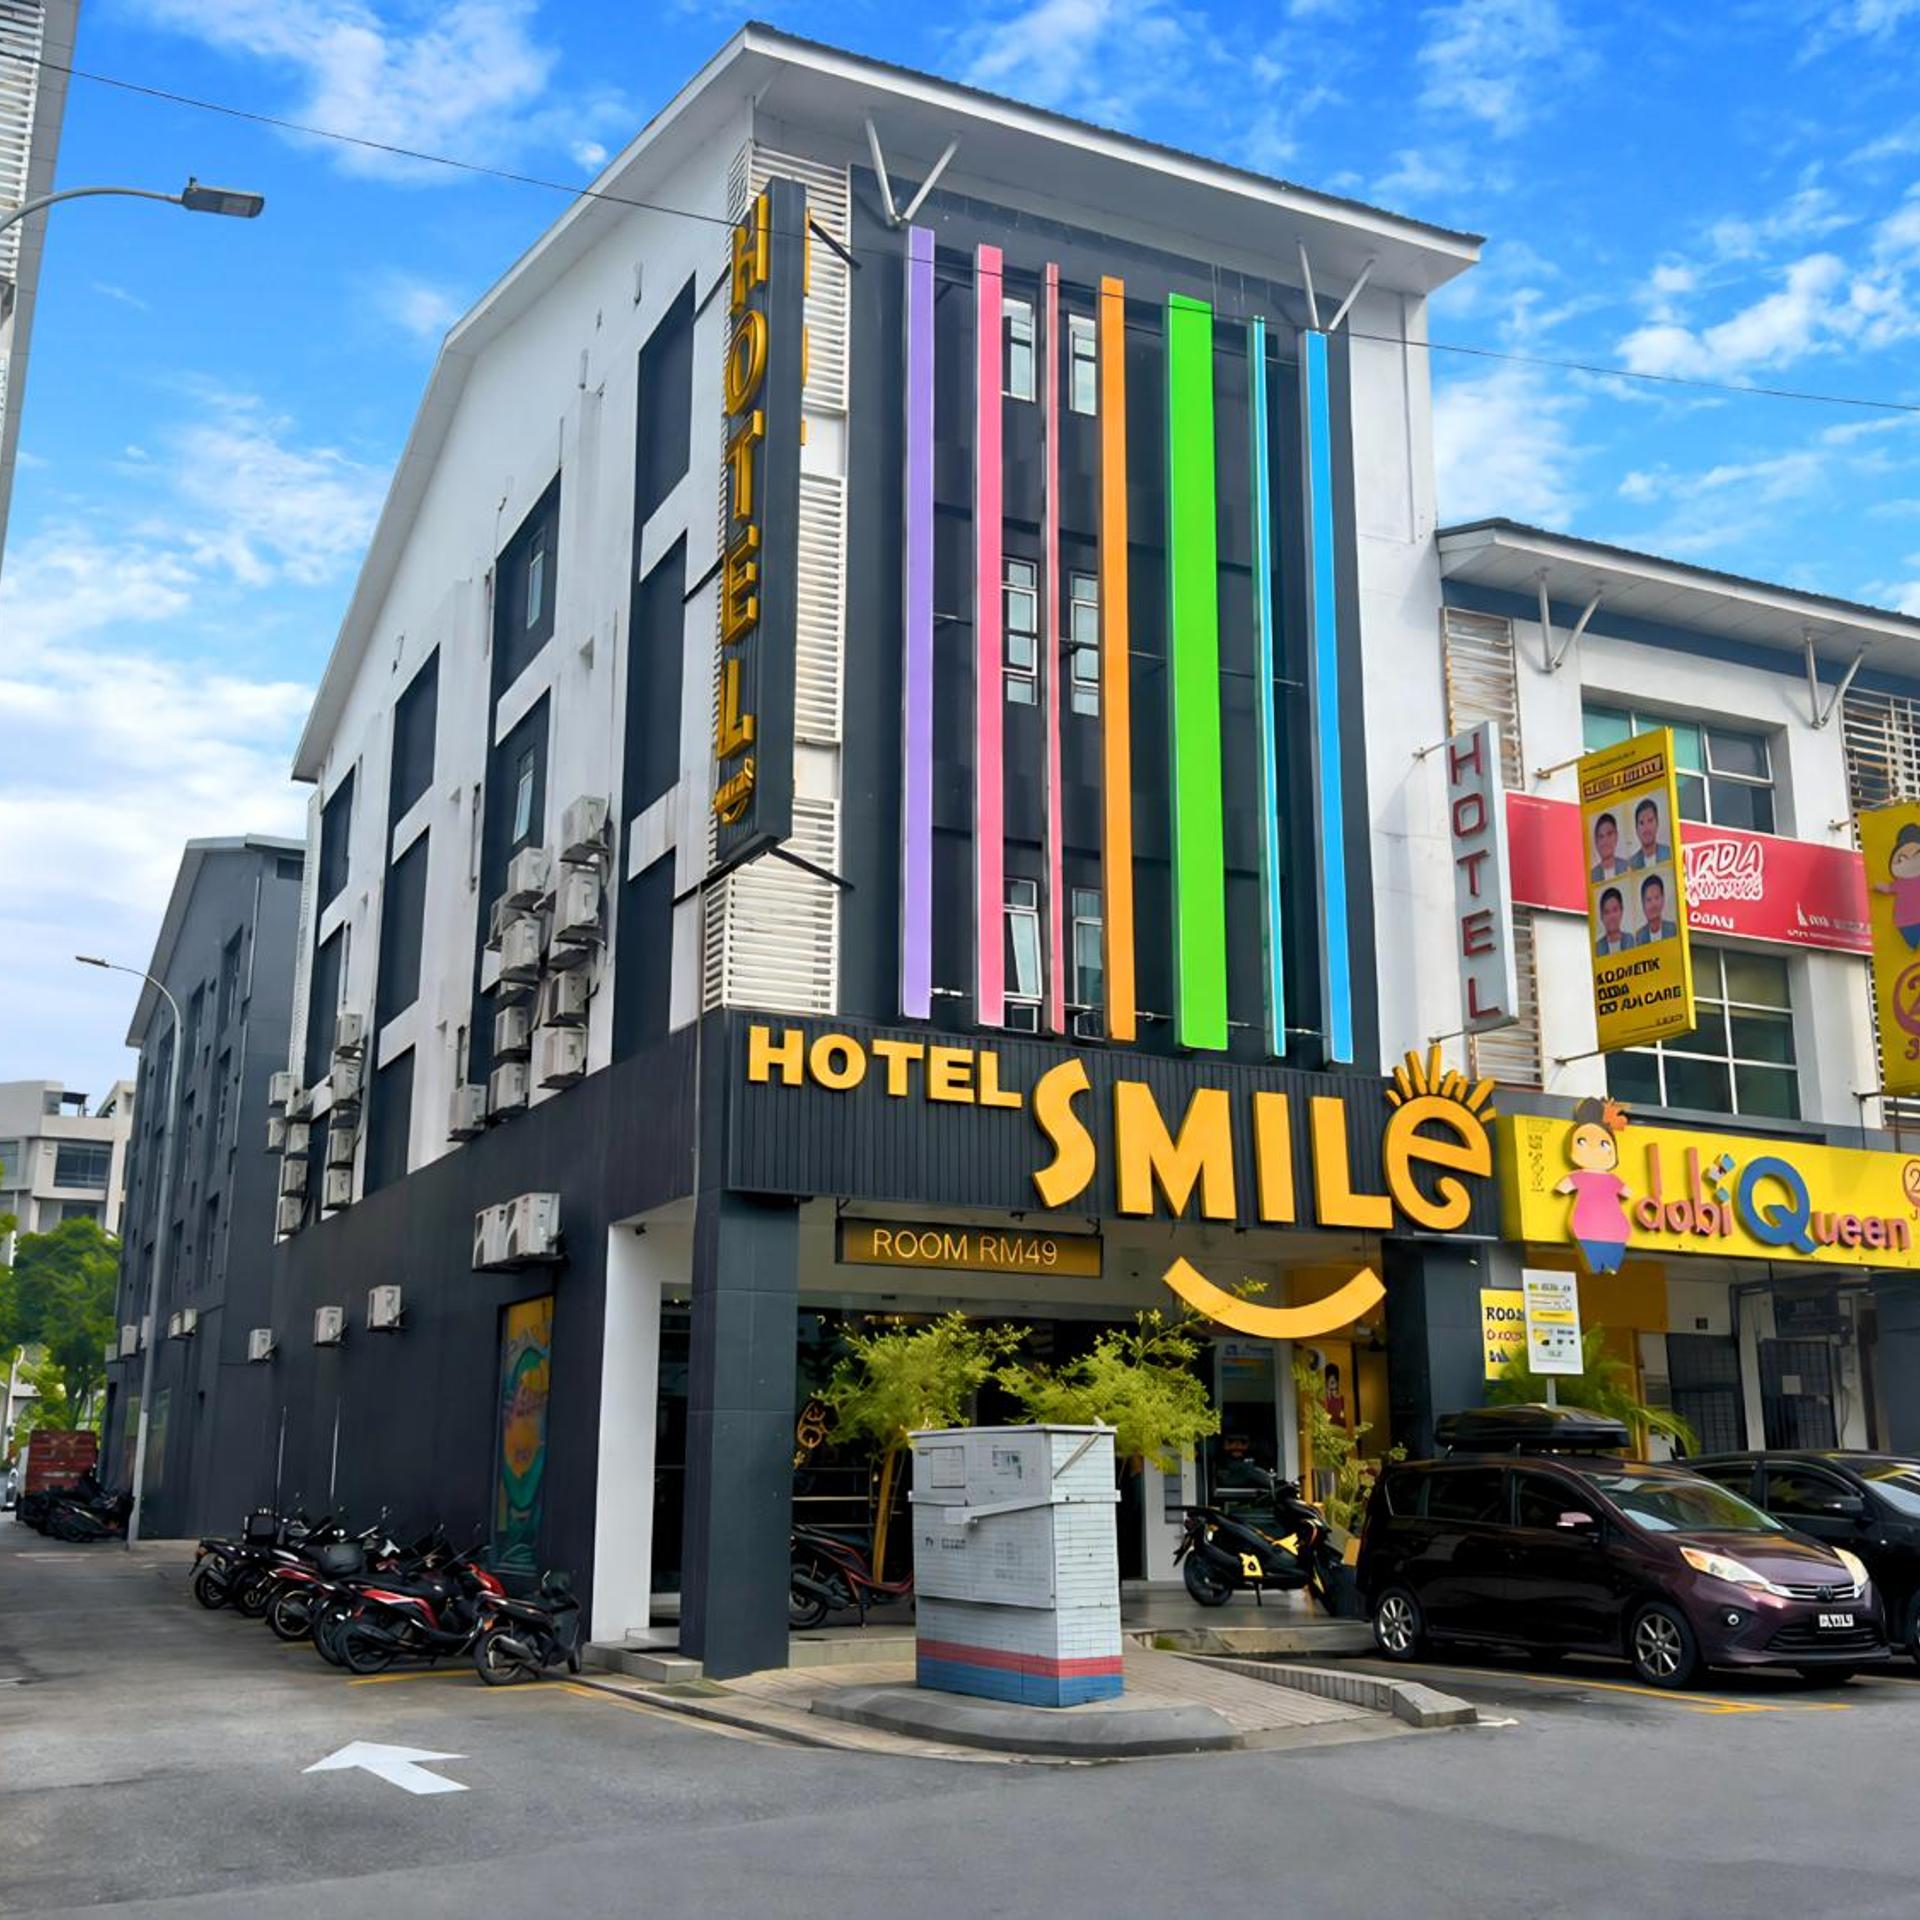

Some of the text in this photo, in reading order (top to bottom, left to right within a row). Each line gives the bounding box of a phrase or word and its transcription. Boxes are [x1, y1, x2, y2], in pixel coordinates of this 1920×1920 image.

[716, 194, 768, 760] HOTEL
[1450, 732, 1500, 1019] HOTEL
[747, 1026, 1023, 1107] HOTEL
[872, 1229, 1059, 1268] ROOM RM49
